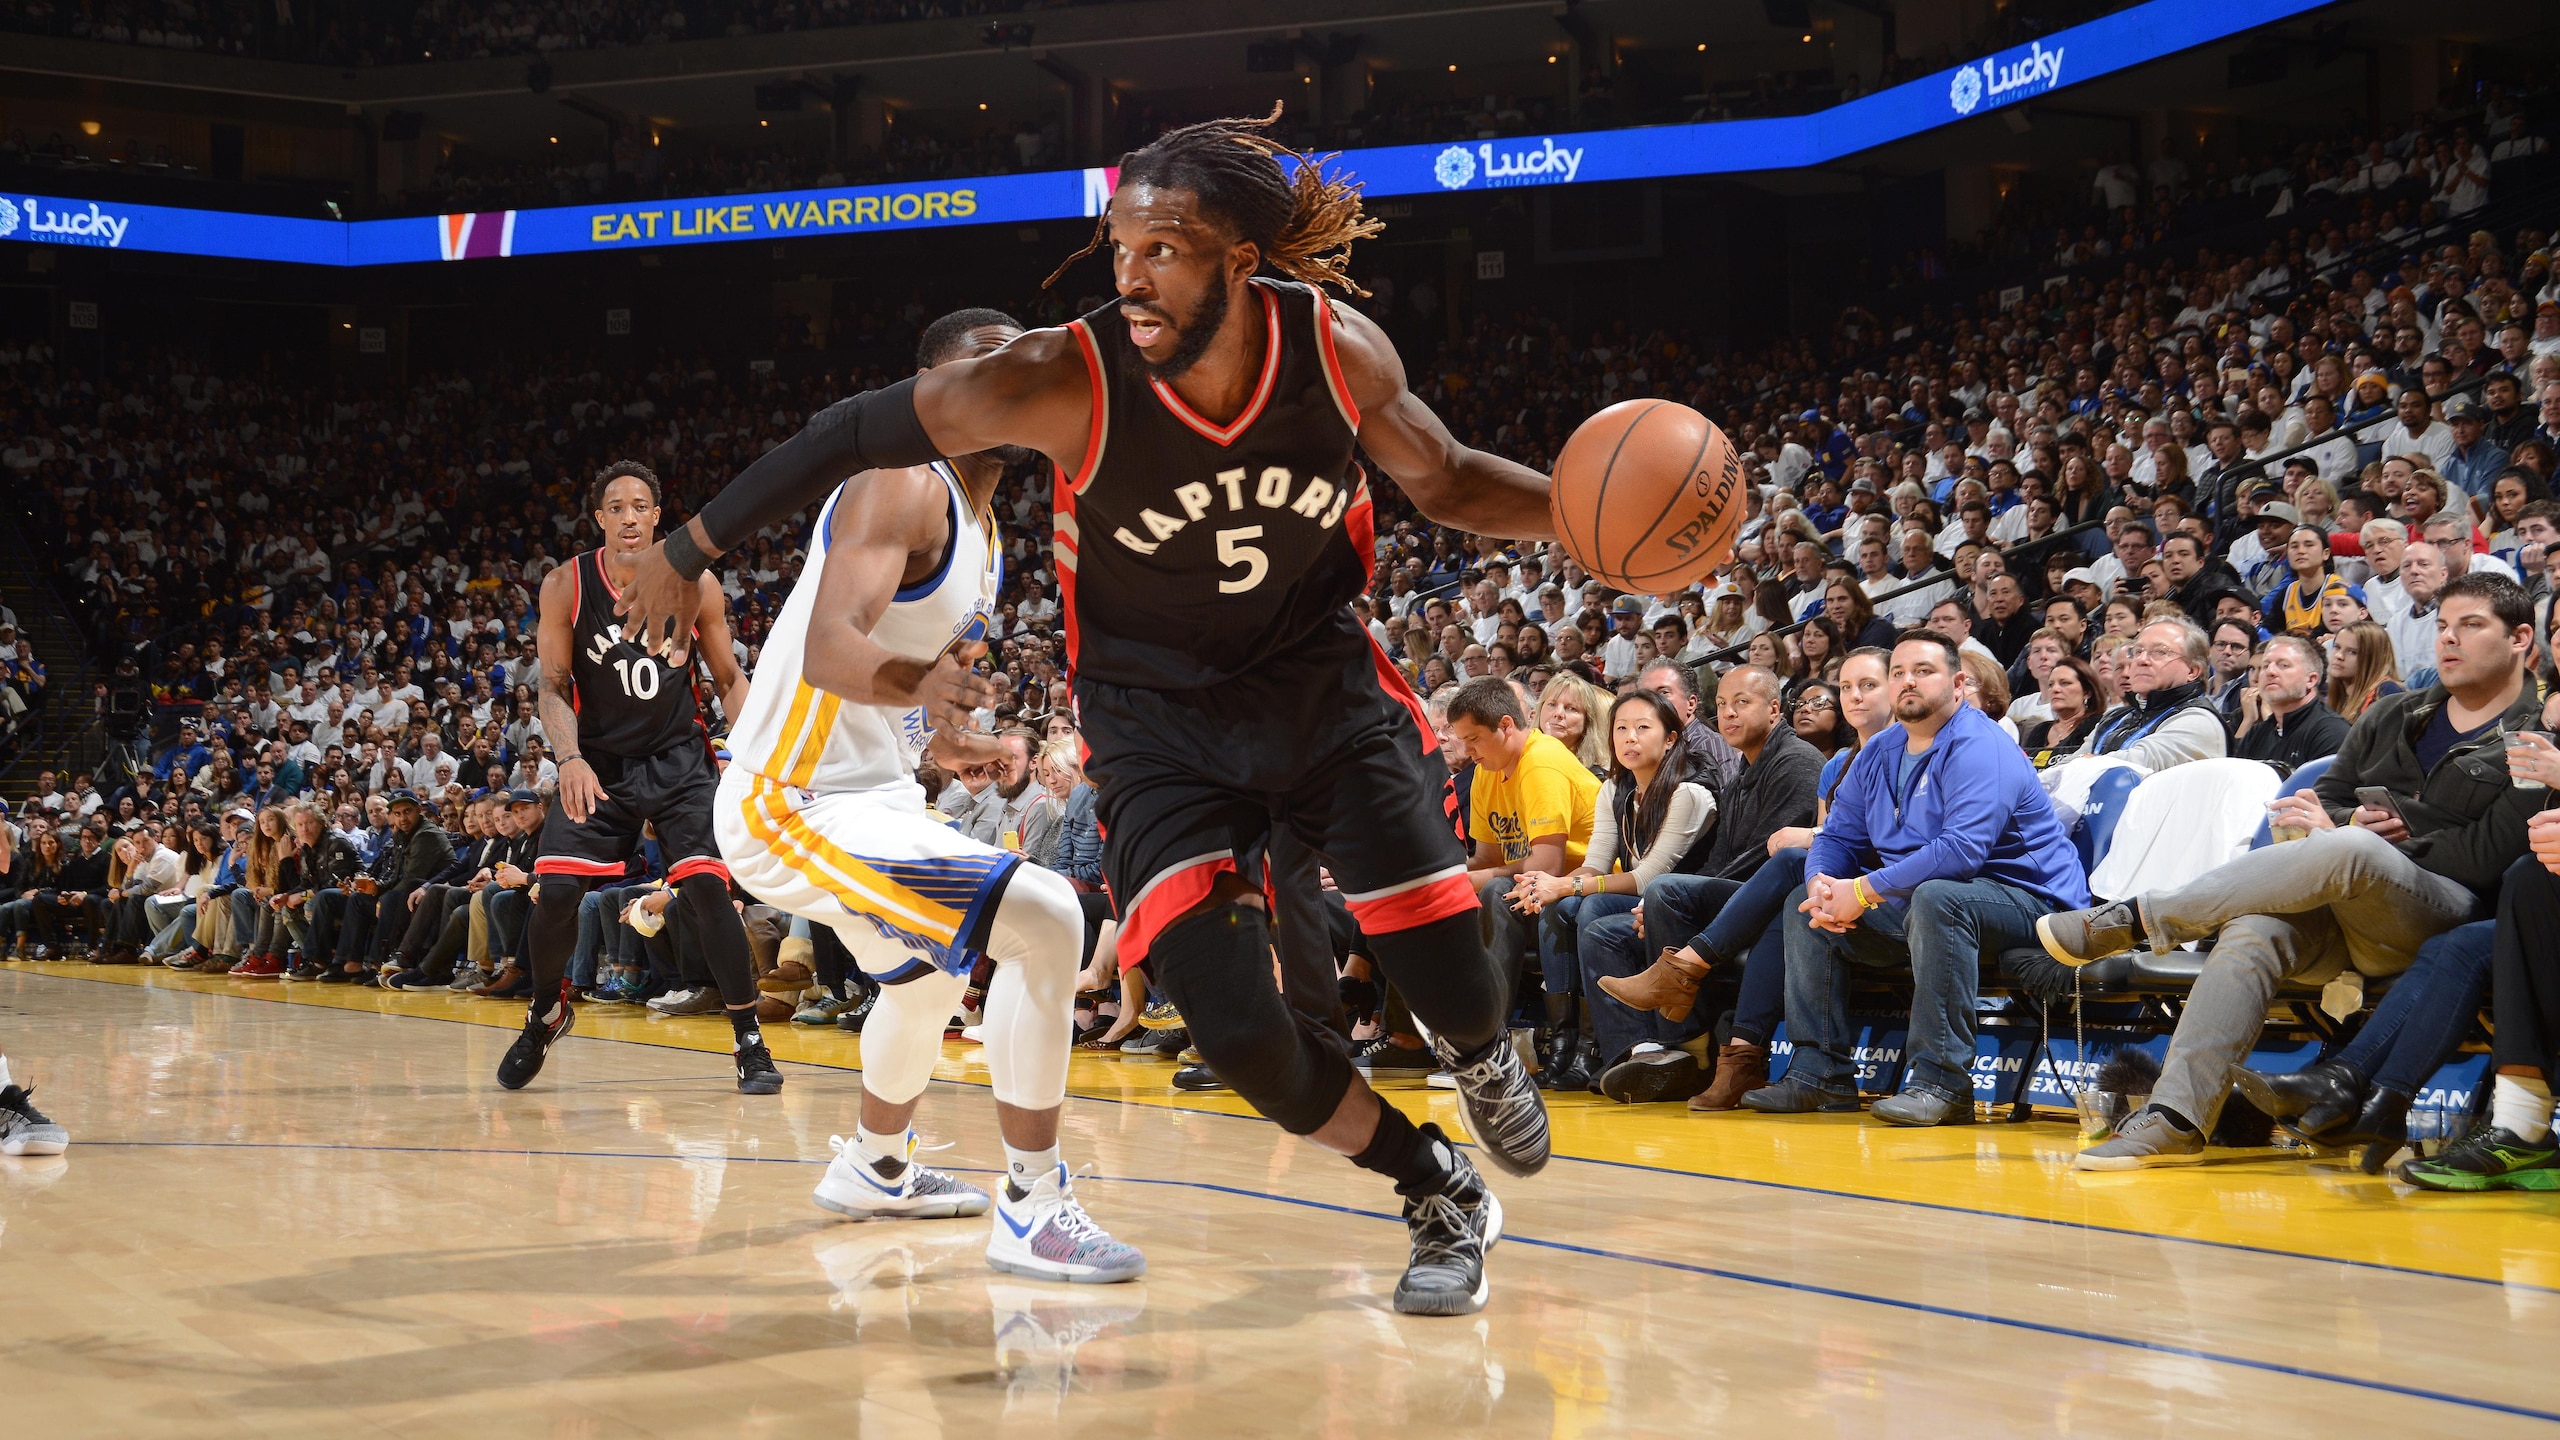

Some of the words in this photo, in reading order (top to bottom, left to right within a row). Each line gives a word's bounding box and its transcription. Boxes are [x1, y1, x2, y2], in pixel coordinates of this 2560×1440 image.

[1983, 41, 2064, 96] Lucky
[1479, 137, 1584, 182] Lucky
[1486, 175, 1561, 188] California
[23, 198, 129, 247] Lucky
[591, 210, 664, 242] EAT
[671, 204, 754, 237] LIKE
[763, 189, 978, 231] WARRIORS
[1480, 264, 1501, 276] 111
[72, 313, 96, 326] 109
[610, 319, 629, 331] 109
[1112, 465, 1348, 556] RAPTORS
[1665, 440, 1740, 560] SPALDING
[1215, 524, 1270, 594] 5
[612, 657, 660, 700] 10
